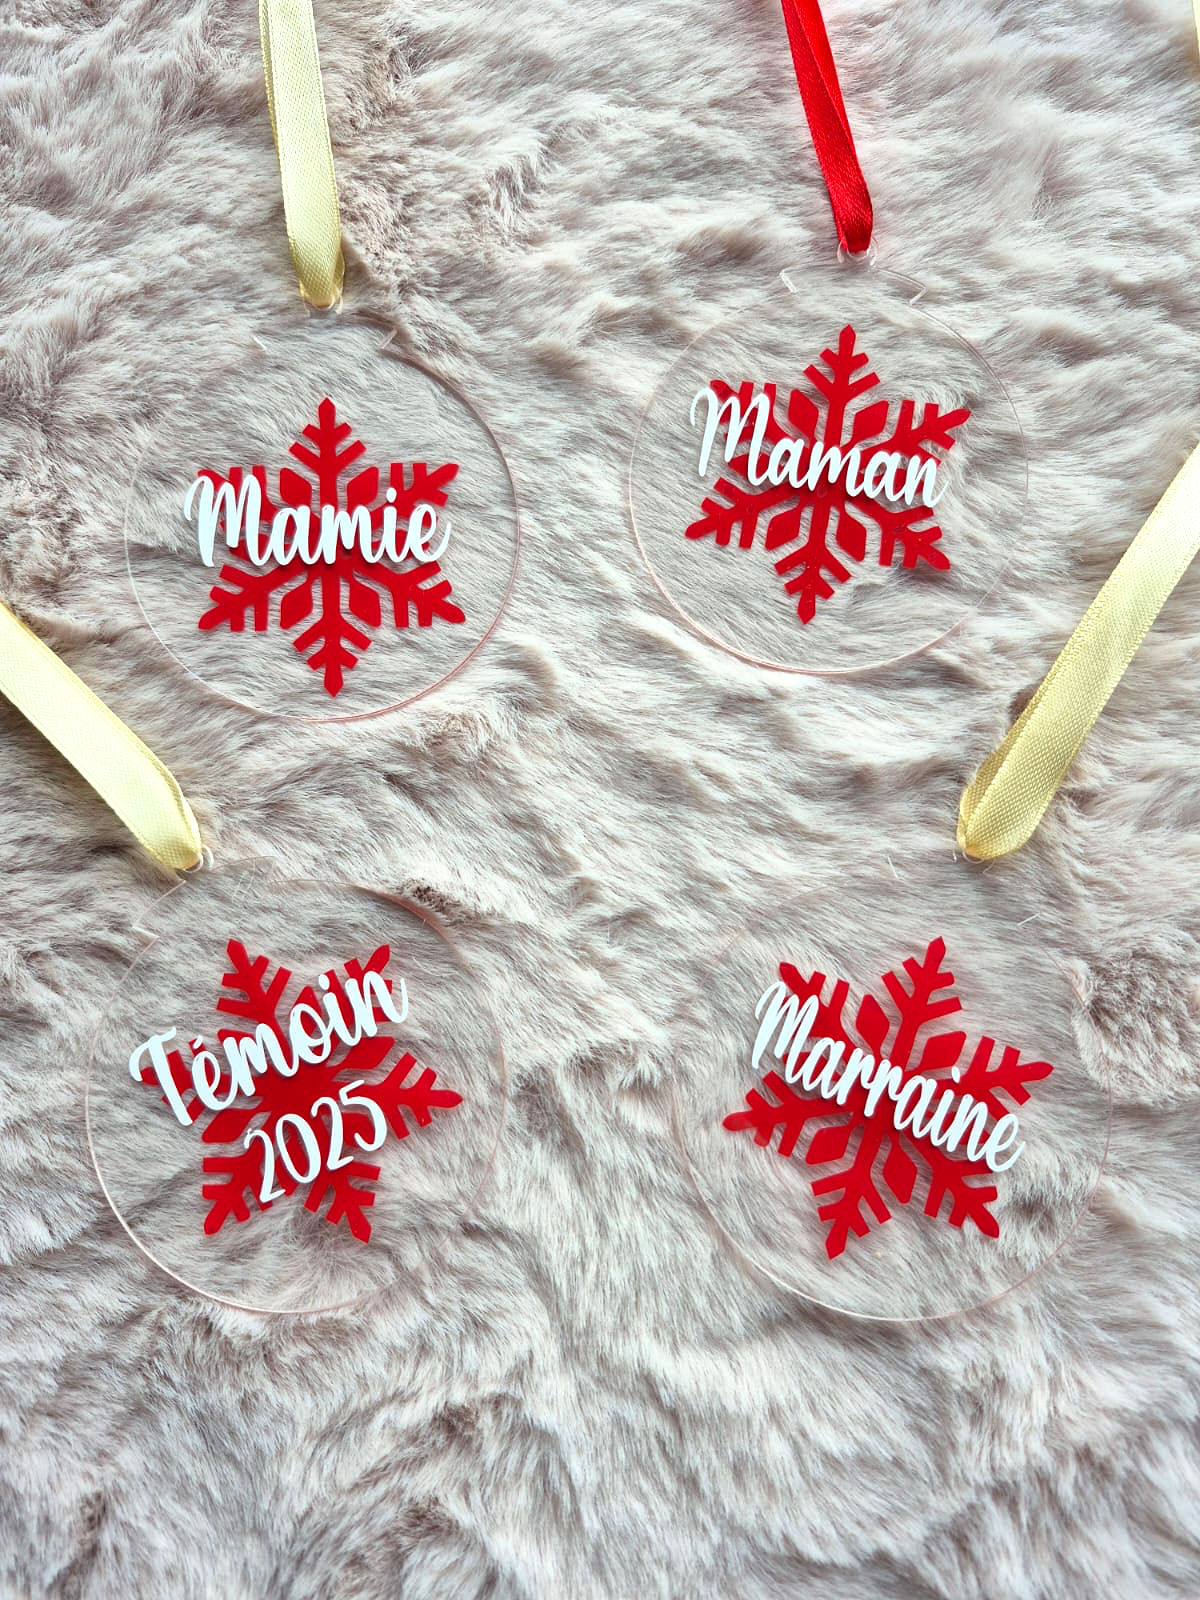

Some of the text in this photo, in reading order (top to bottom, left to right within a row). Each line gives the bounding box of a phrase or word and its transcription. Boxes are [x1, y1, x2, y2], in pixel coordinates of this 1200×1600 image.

[689, 388, 948, 508] Maman
[184, 474, 452, 567] Mamie
[129, 968, 409, 1127] Témoin
[751, 980, 1025, 1173] Marraine
[243, 1079, 388, 1204] 2025
